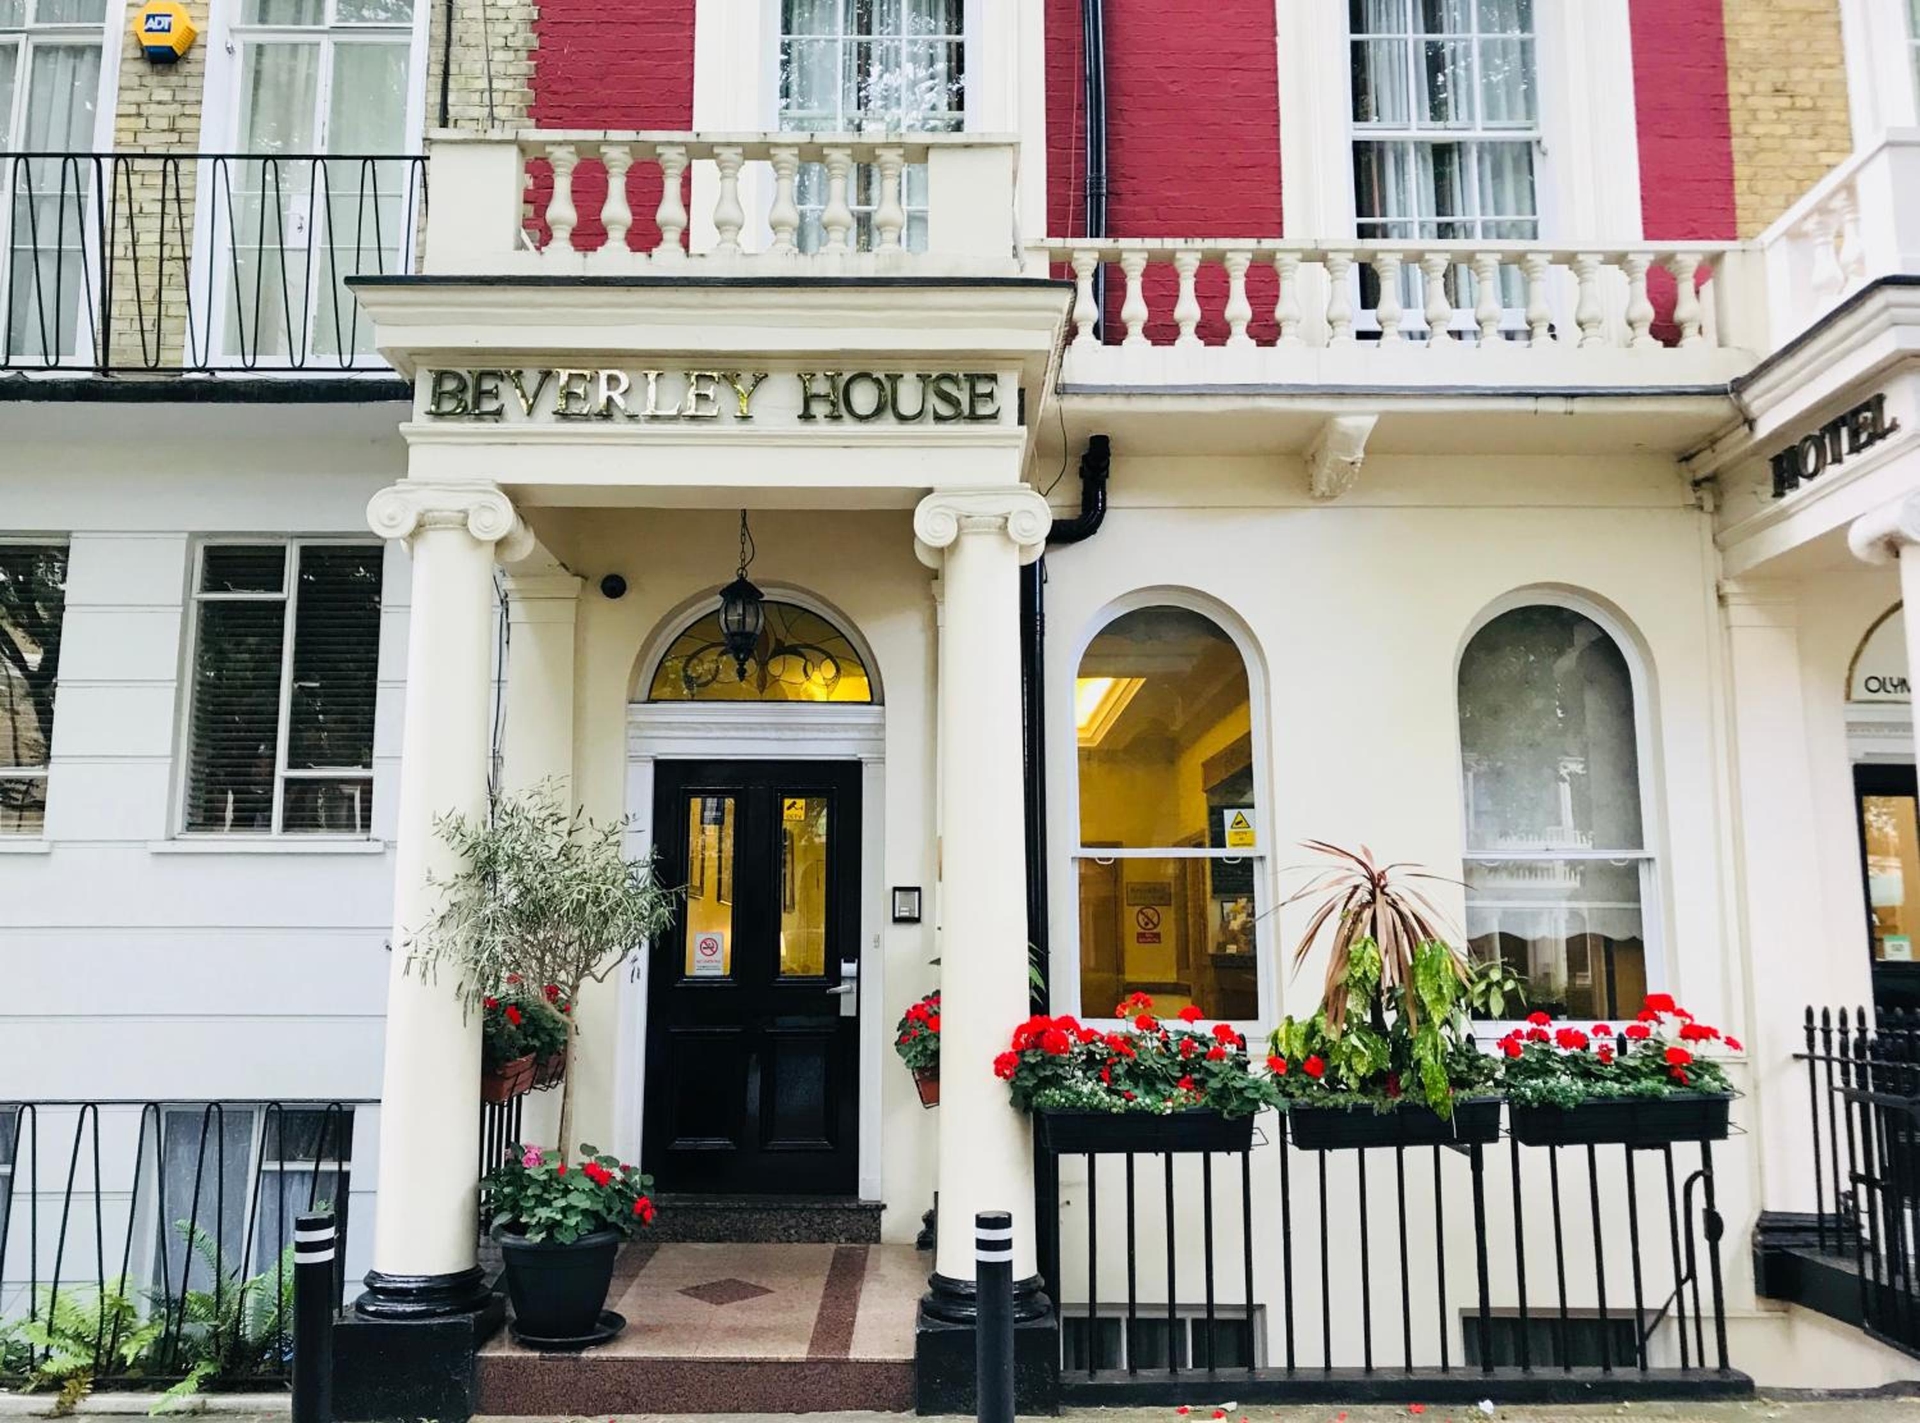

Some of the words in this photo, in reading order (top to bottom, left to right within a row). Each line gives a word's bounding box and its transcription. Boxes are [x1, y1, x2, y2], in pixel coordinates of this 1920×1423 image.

[145, 16, 172, 30] ADT
[424, 368, 768, 419] BEVERLEY
[797, 371, 1001, 422] HOUSE
[1769, 393, 1901, 498] HOTEL
